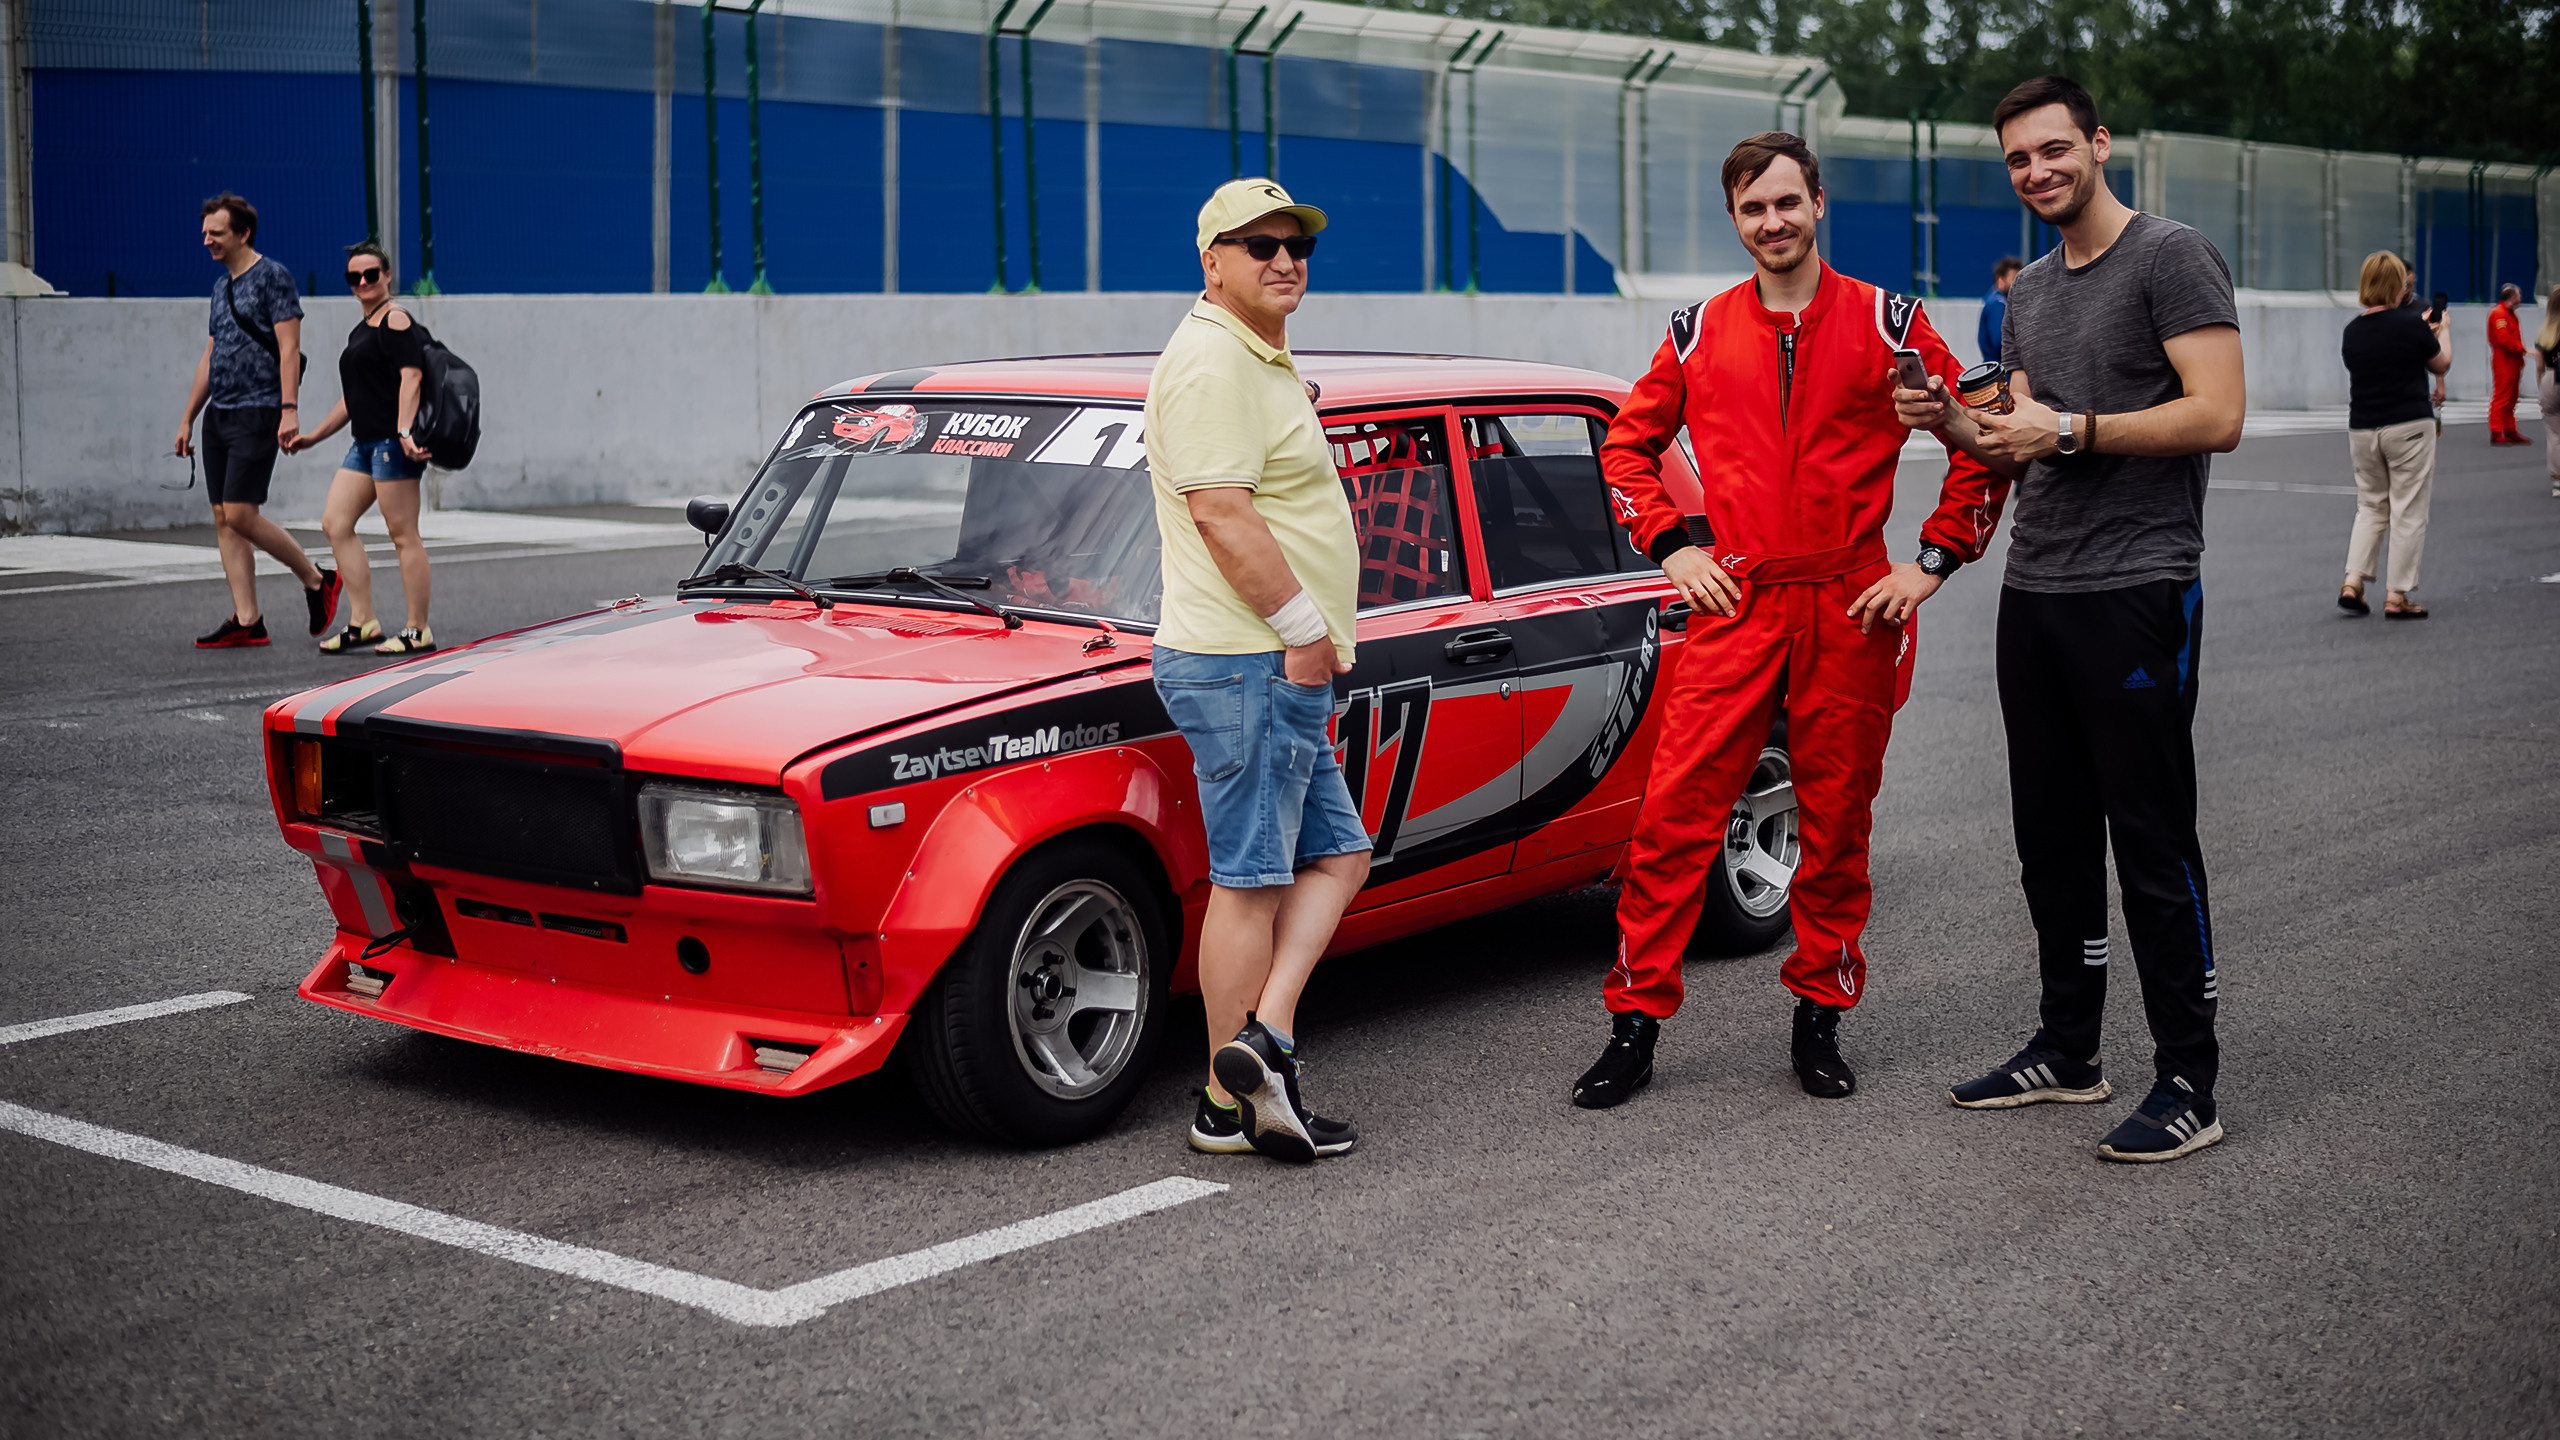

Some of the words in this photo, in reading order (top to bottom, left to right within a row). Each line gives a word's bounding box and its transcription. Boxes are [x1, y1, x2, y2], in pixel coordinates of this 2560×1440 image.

[943, 411, 1031, 439] КУБОК
[930, 438, 1015, 459] КЛАССИКИ
[1336, 677, 1432, 866] 17
